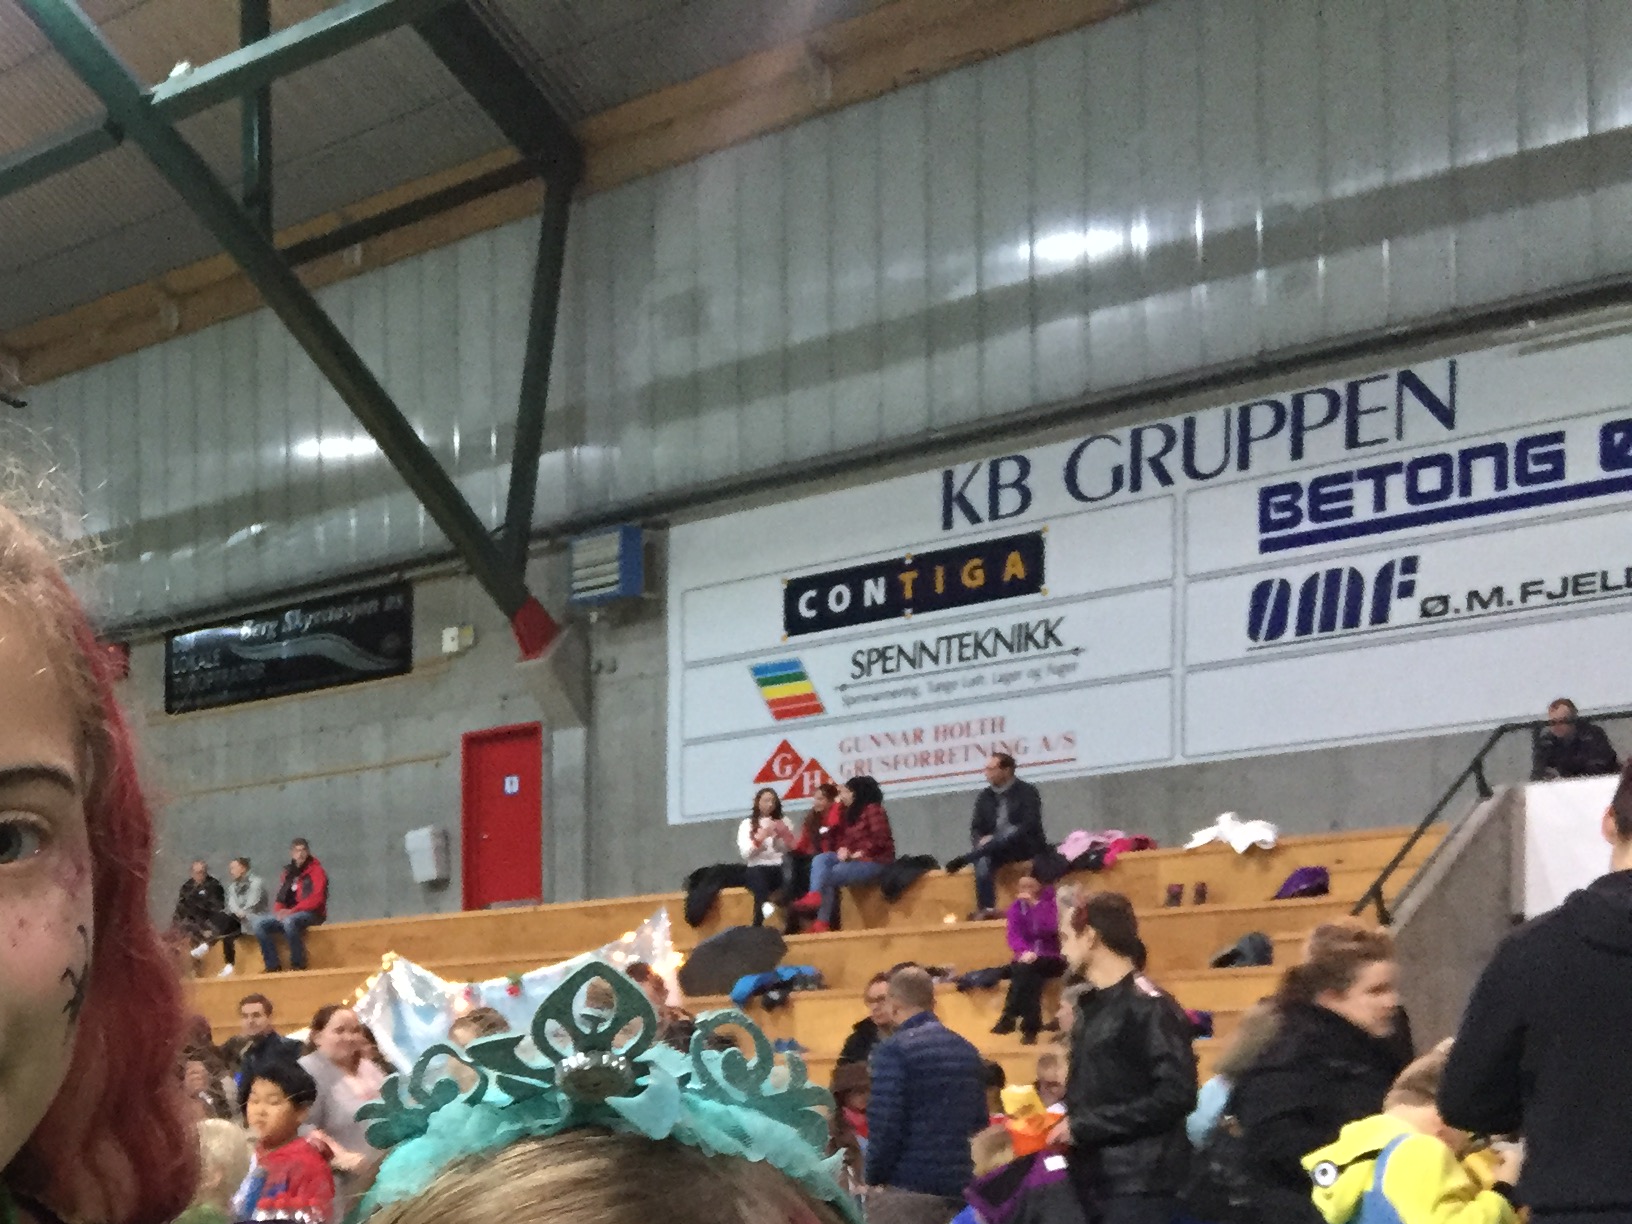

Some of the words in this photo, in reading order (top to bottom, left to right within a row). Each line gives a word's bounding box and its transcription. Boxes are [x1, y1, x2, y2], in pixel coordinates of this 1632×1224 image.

[942, 455, 1032, 530] KB
[1063, 358, 1457, 502] GRUPPEN
[1258, 430, 1566, 534] BETONG
[798, 550, 1027, 619] CONTIGA
[850, 616, 1065, 680] SPENNTEKNIKK
[772, 753, 792, 778] G
[839, 727, 924, 754] GUNNAR
[933, 716, 1006, 743] HOLTH
